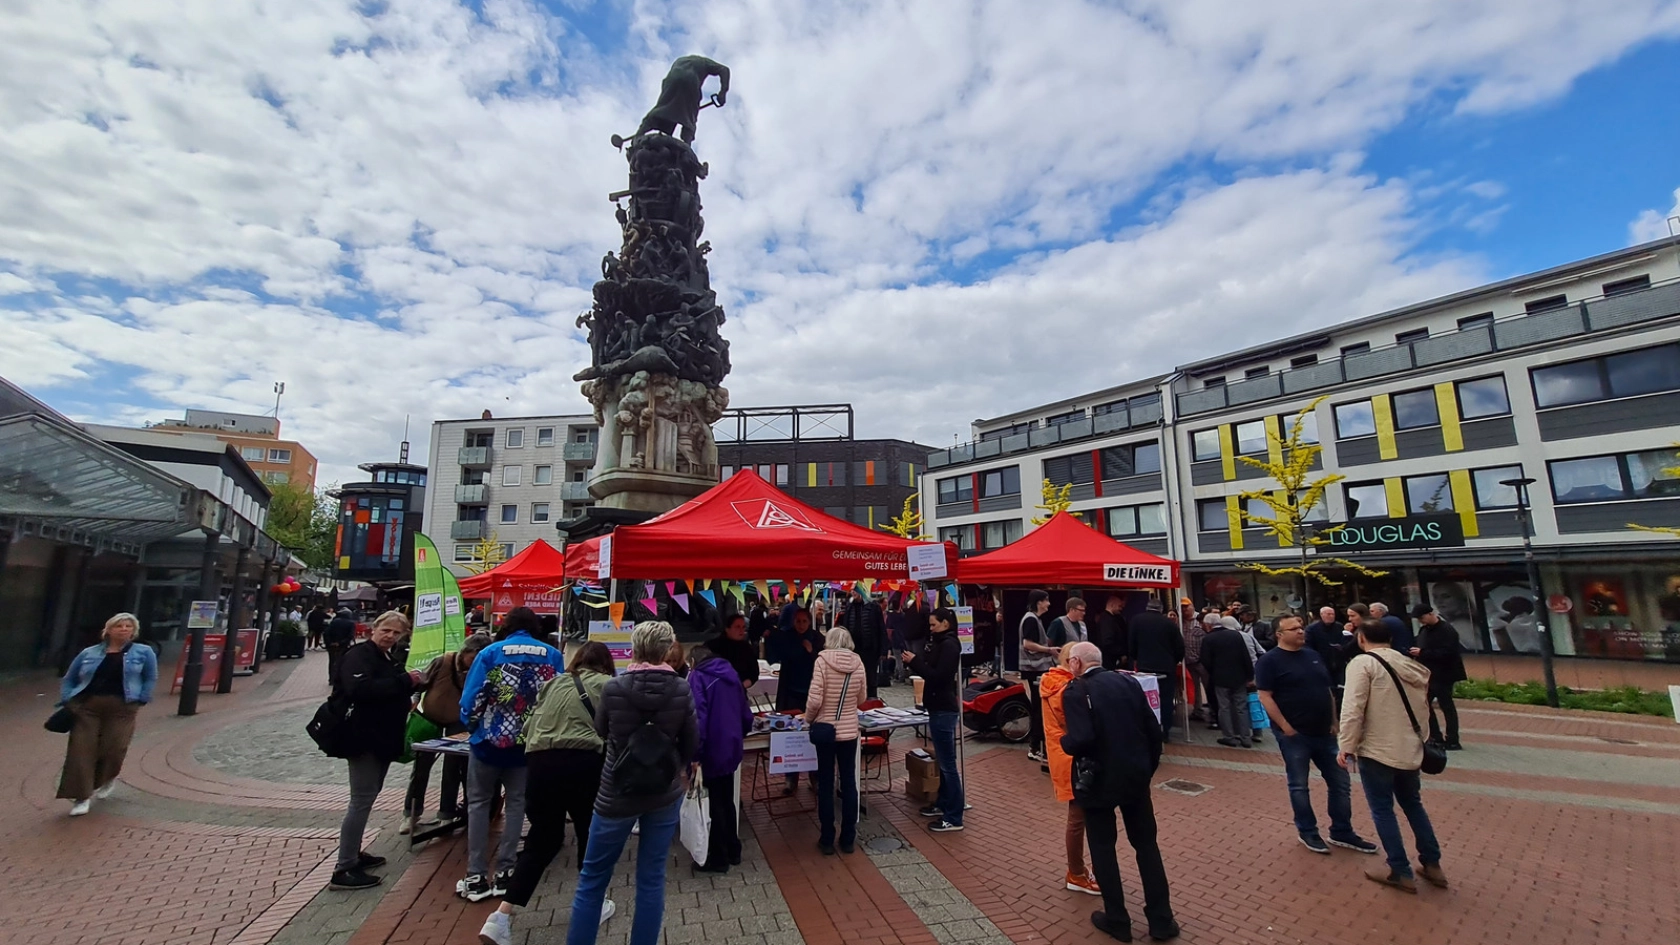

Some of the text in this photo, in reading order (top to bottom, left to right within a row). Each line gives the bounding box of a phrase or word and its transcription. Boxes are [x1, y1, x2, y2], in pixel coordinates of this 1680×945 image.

[1330, 522, 1442, 546] DOUGLAS
[832, 550, 882, 561] GEMEINSAM
[864, 562, 889, 571] GUTES
[890, 562, 909, 571] LEBE
[1108, 567, 1127, 578] DIE
